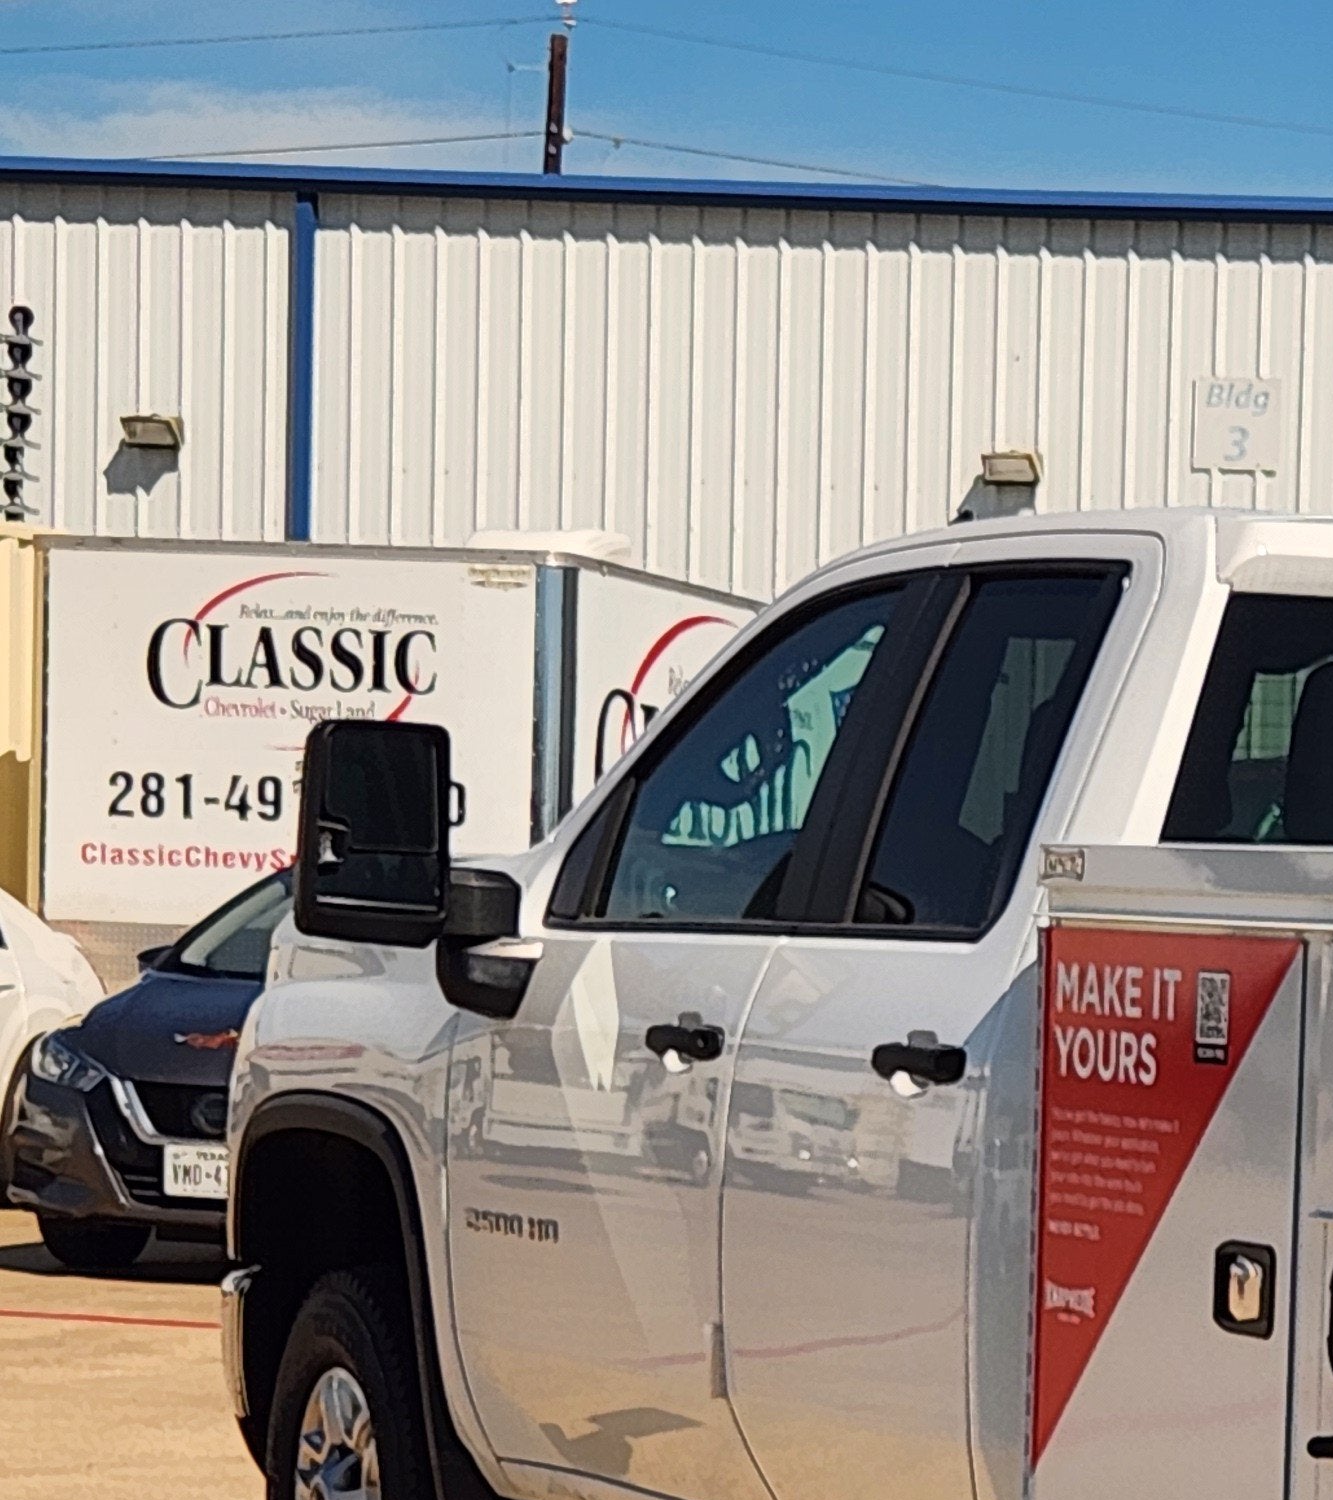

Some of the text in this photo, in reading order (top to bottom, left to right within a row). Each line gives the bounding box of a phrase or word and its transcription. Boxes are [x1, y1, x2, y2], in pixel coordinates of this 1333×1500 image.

[1206, 383, 1270, 417] Bldg
[1223, 425, 1250, 462] 3
[147, 618, 438, 708] CLASSIC
[1056, 961, 1182, 1021] MAKE IT
[1054, 1025, 1158, 1086] YOURS
